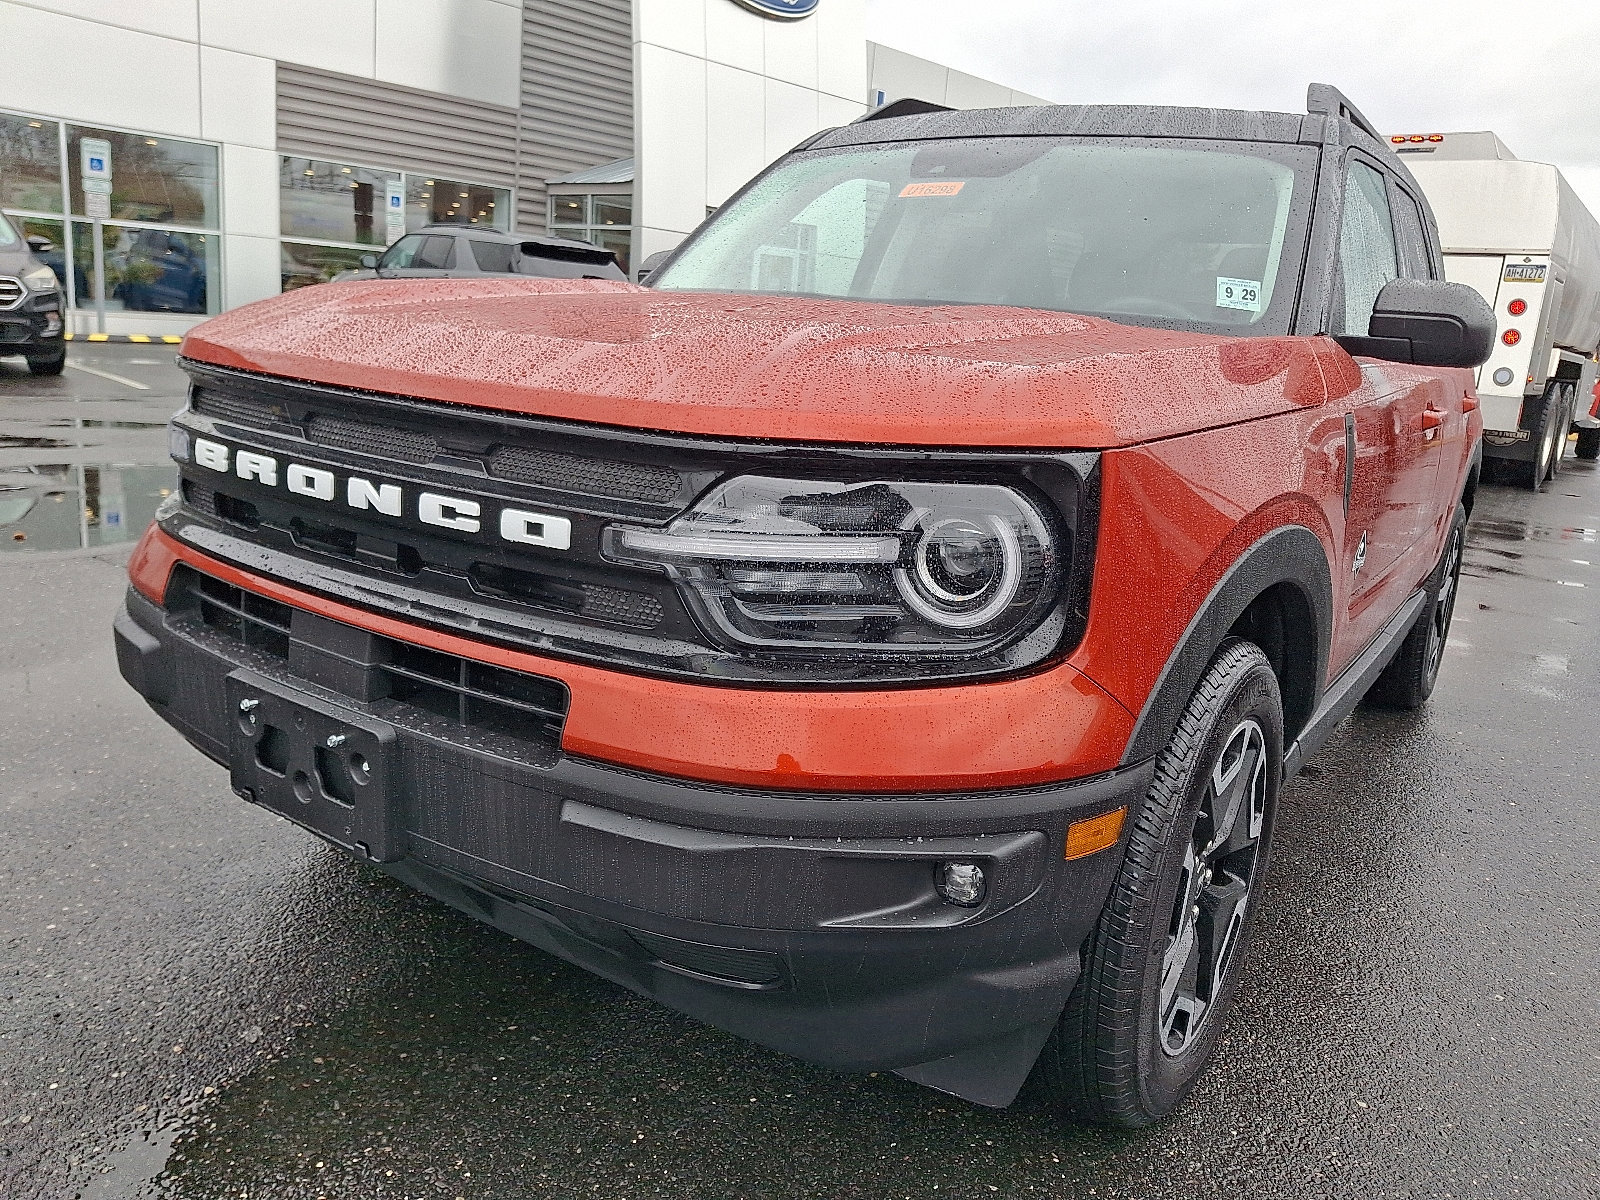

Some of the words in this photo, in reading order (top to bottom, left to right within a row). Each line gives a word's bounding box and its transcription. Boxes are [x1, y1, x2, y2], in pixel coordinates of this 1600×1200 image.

[1225, 286, 1234, 299] 9
[1241, 288, 1257, 302] 29
[194, 438, 572, 551] BRONCO
